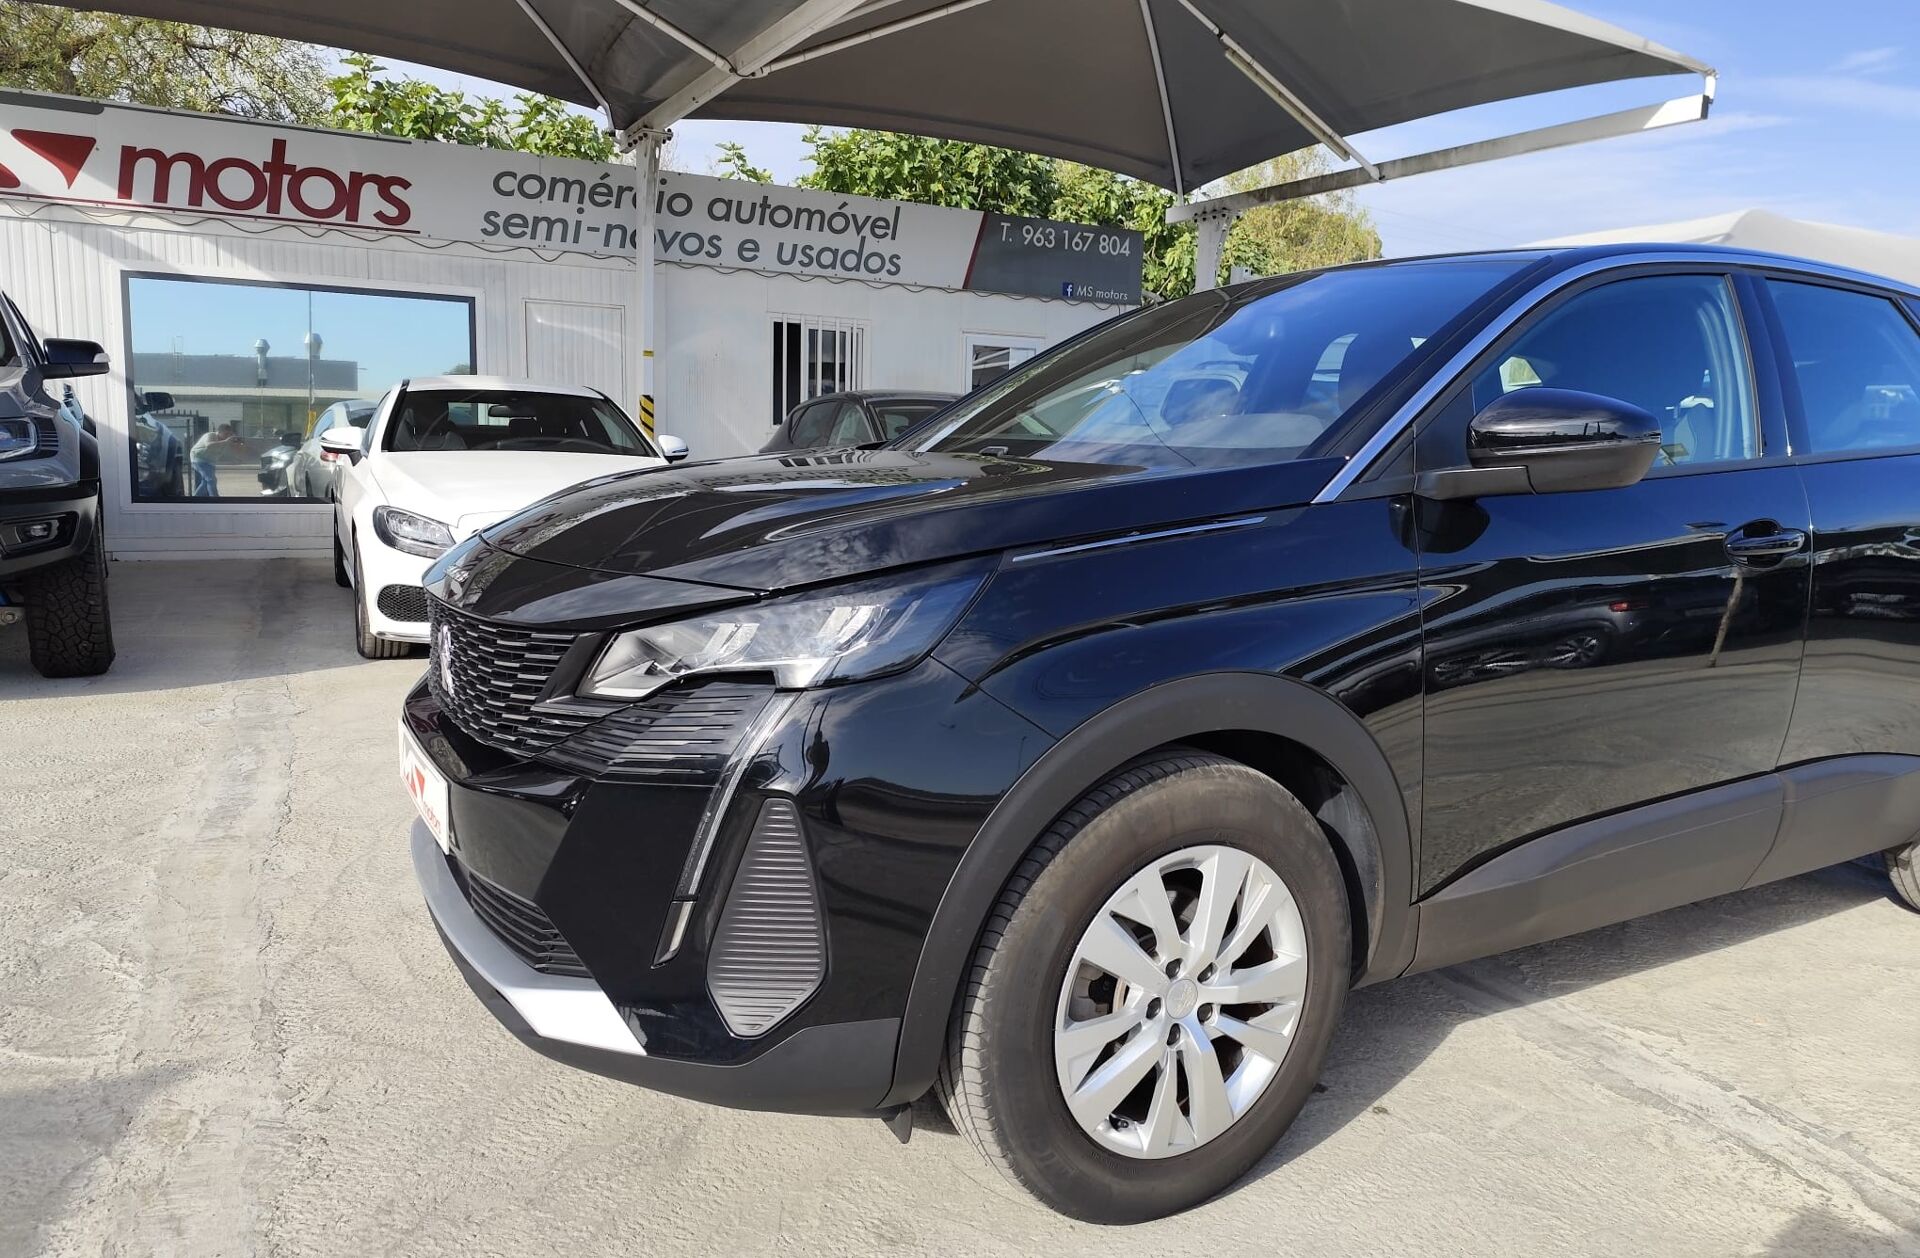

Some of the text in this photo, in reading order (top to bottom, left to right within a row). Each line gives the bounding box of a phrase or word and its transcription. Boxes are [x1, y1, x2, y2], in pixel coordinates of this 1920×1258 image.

[117, 138, 412, 226] motors
[493, 170, 900, 241] comério automóvel
[738, 238, 760, 262] e
[776, 236, 901, 276] usados
[1001, 222, 1130, 257] T. 963 167 804
[1076, 285, 1093, 297] MS
[1096, 288, 1128, 301] motors
